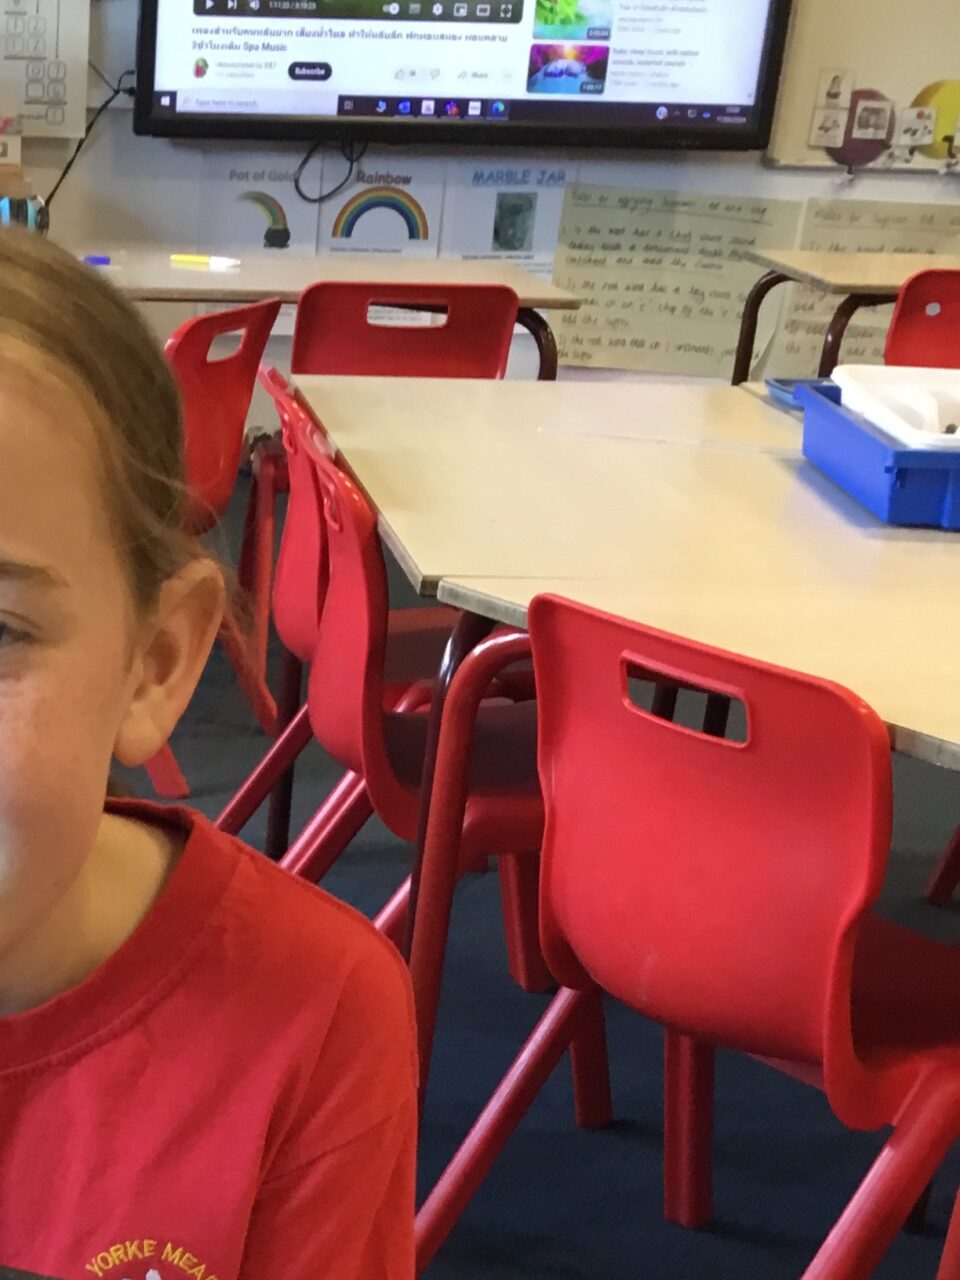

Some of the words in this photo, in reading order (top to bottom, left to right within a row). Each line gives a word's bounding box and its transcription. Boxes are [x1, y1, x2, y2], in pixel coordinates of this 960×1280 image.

[243, 41, 260, 53] Spa
[261, 41, 288, 52] Music
[294, 67, 326, 76] Subscribe
[229, 169, 249, 182] Pot
[252, 169, 266, 182] of
[356, 170, 413, 185] Rainbow
[472, 170, 531, 184] MARBLE
[536, 170, 566, 184] JAR
[85, 1239, 158, 1278] YORKE
